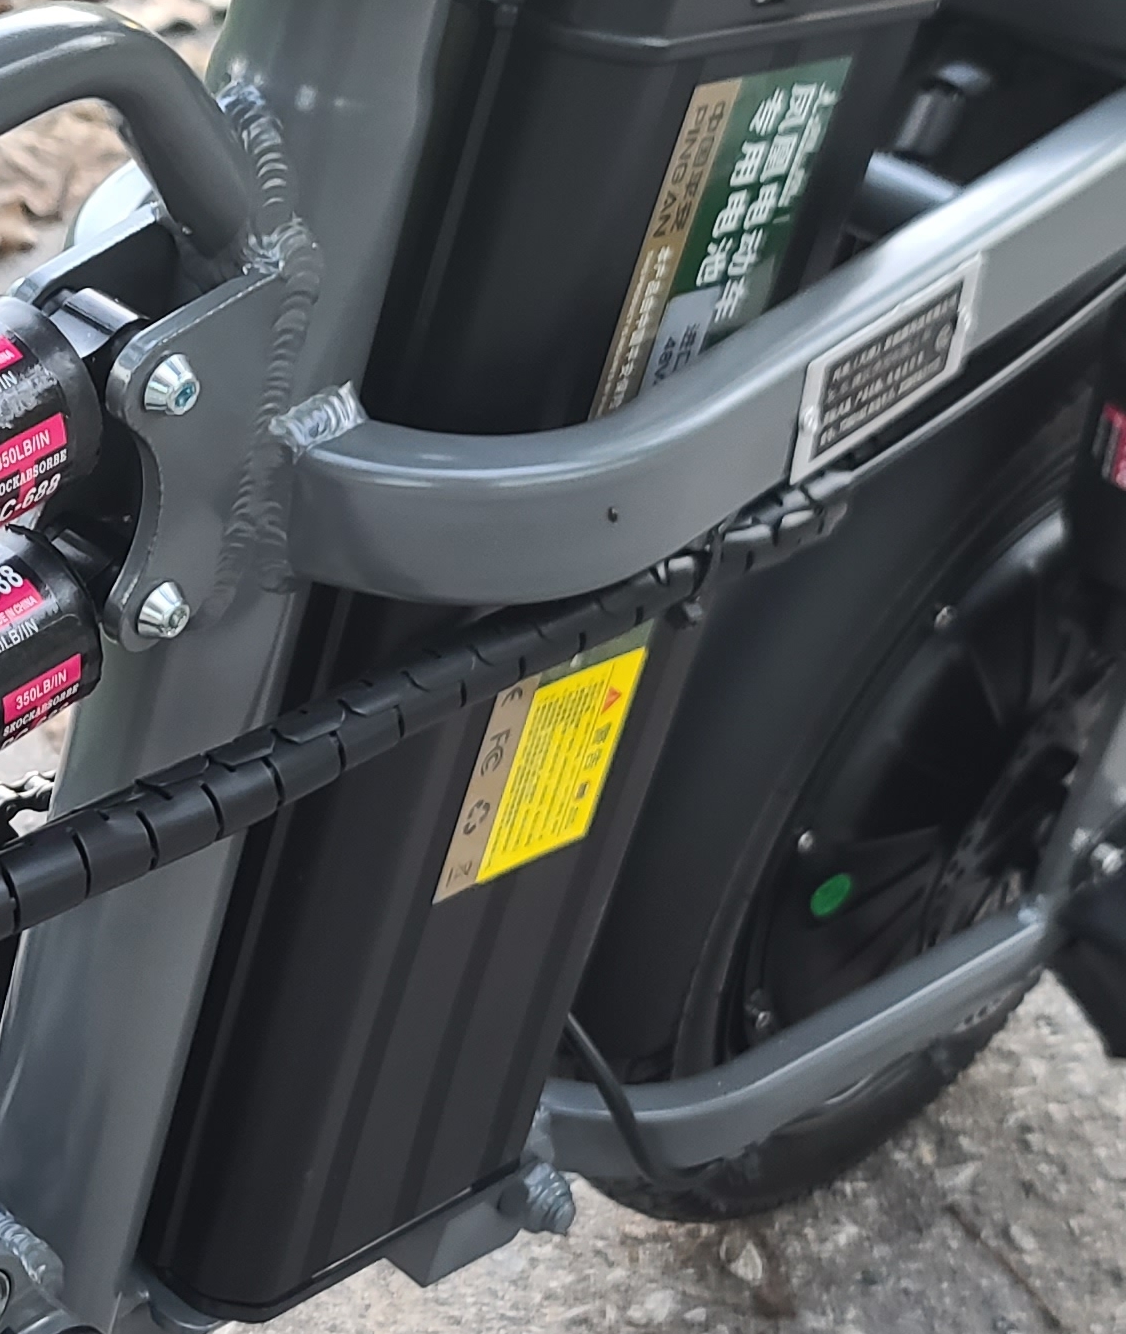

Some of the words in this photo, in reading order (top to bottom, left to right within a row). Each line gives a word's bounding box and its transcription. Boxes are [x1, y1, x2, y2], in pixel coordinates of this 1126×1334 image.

[670, 101, 725, 233] 中国平安
[672, 104, 708, 185] PING
[653, 190, 676, 238] AN
[696, 86, 786, 288] 专用电池
[714, 82, 818, 324] 凤凰电动车
[13, 595, 38, 615] CHINA
[15, 668, 67, 710] 350LB/IN
